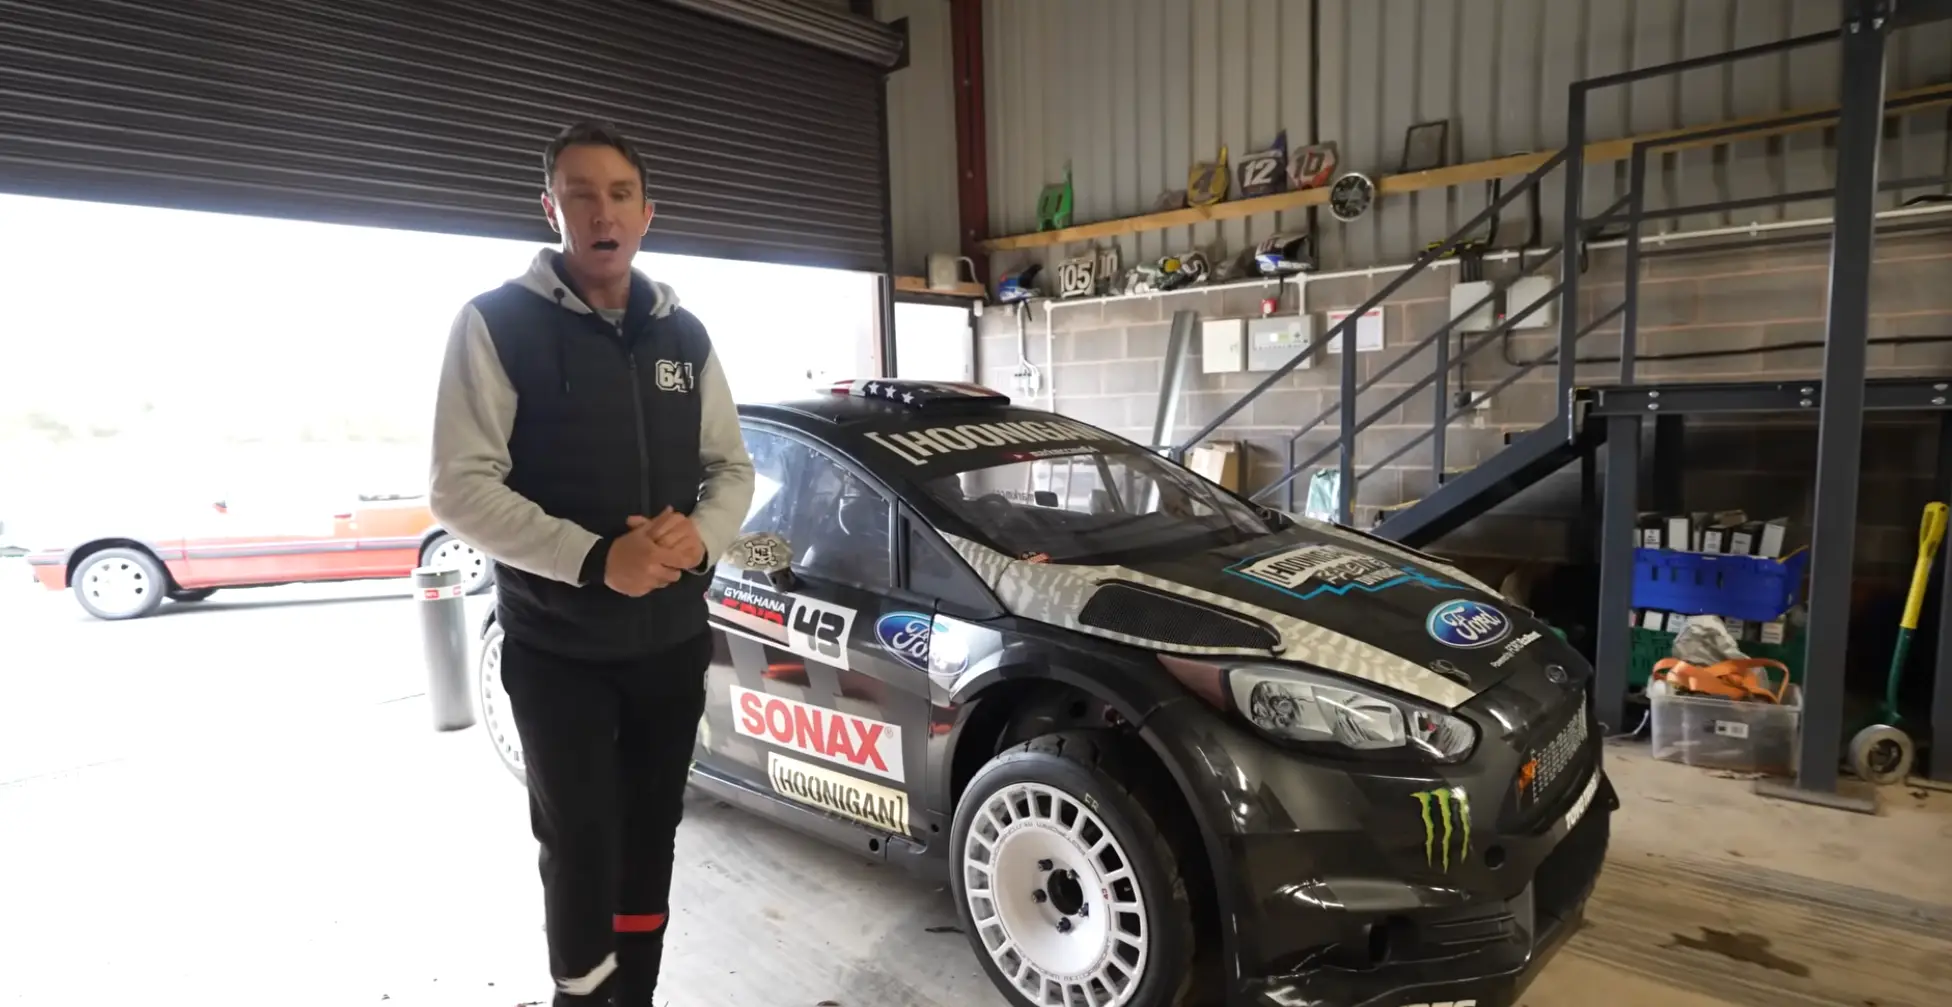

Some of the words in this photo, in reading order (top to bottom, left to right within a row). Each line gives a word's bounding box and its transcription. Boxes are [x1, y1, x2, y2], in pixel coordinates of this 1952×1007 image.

[1243, 158, 1277, 187] 12
[1058, 264, 1092, 291] 105
[656, 359, 694, 393] 64
[724, 587, 786, 614] GYMKHANA
[793, 605, 845, 659] 43
[1440, 606, 1501, 641] Ford
